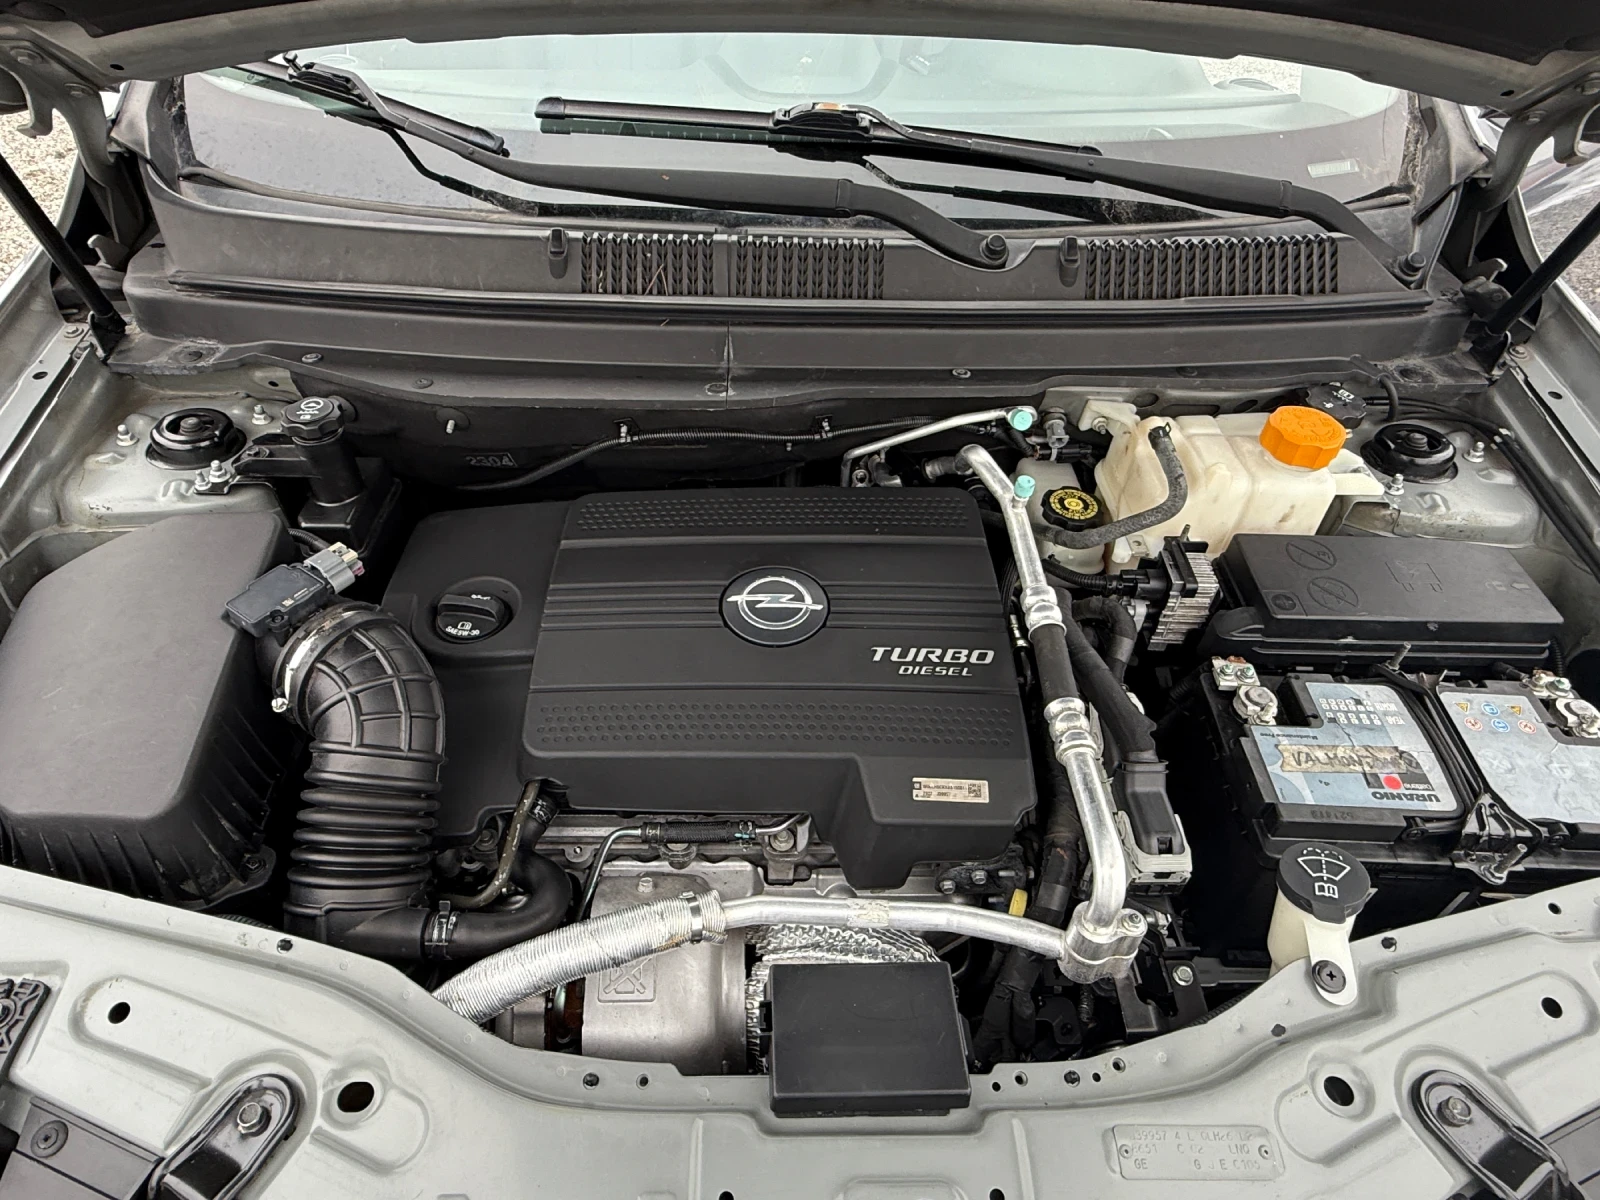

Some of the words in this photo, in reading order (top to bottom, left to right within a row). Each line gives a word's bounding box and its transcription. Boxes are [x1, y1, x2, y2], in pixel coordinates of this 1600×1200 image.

[445, 625, 459, 635] SAE
[870, 646, 995, 664] TURBO
[898, 665, 973, 676] DIESEL
[1385, 715, 1406, 725] YEAR
[1371, 791, 1441, 803] URANIO
